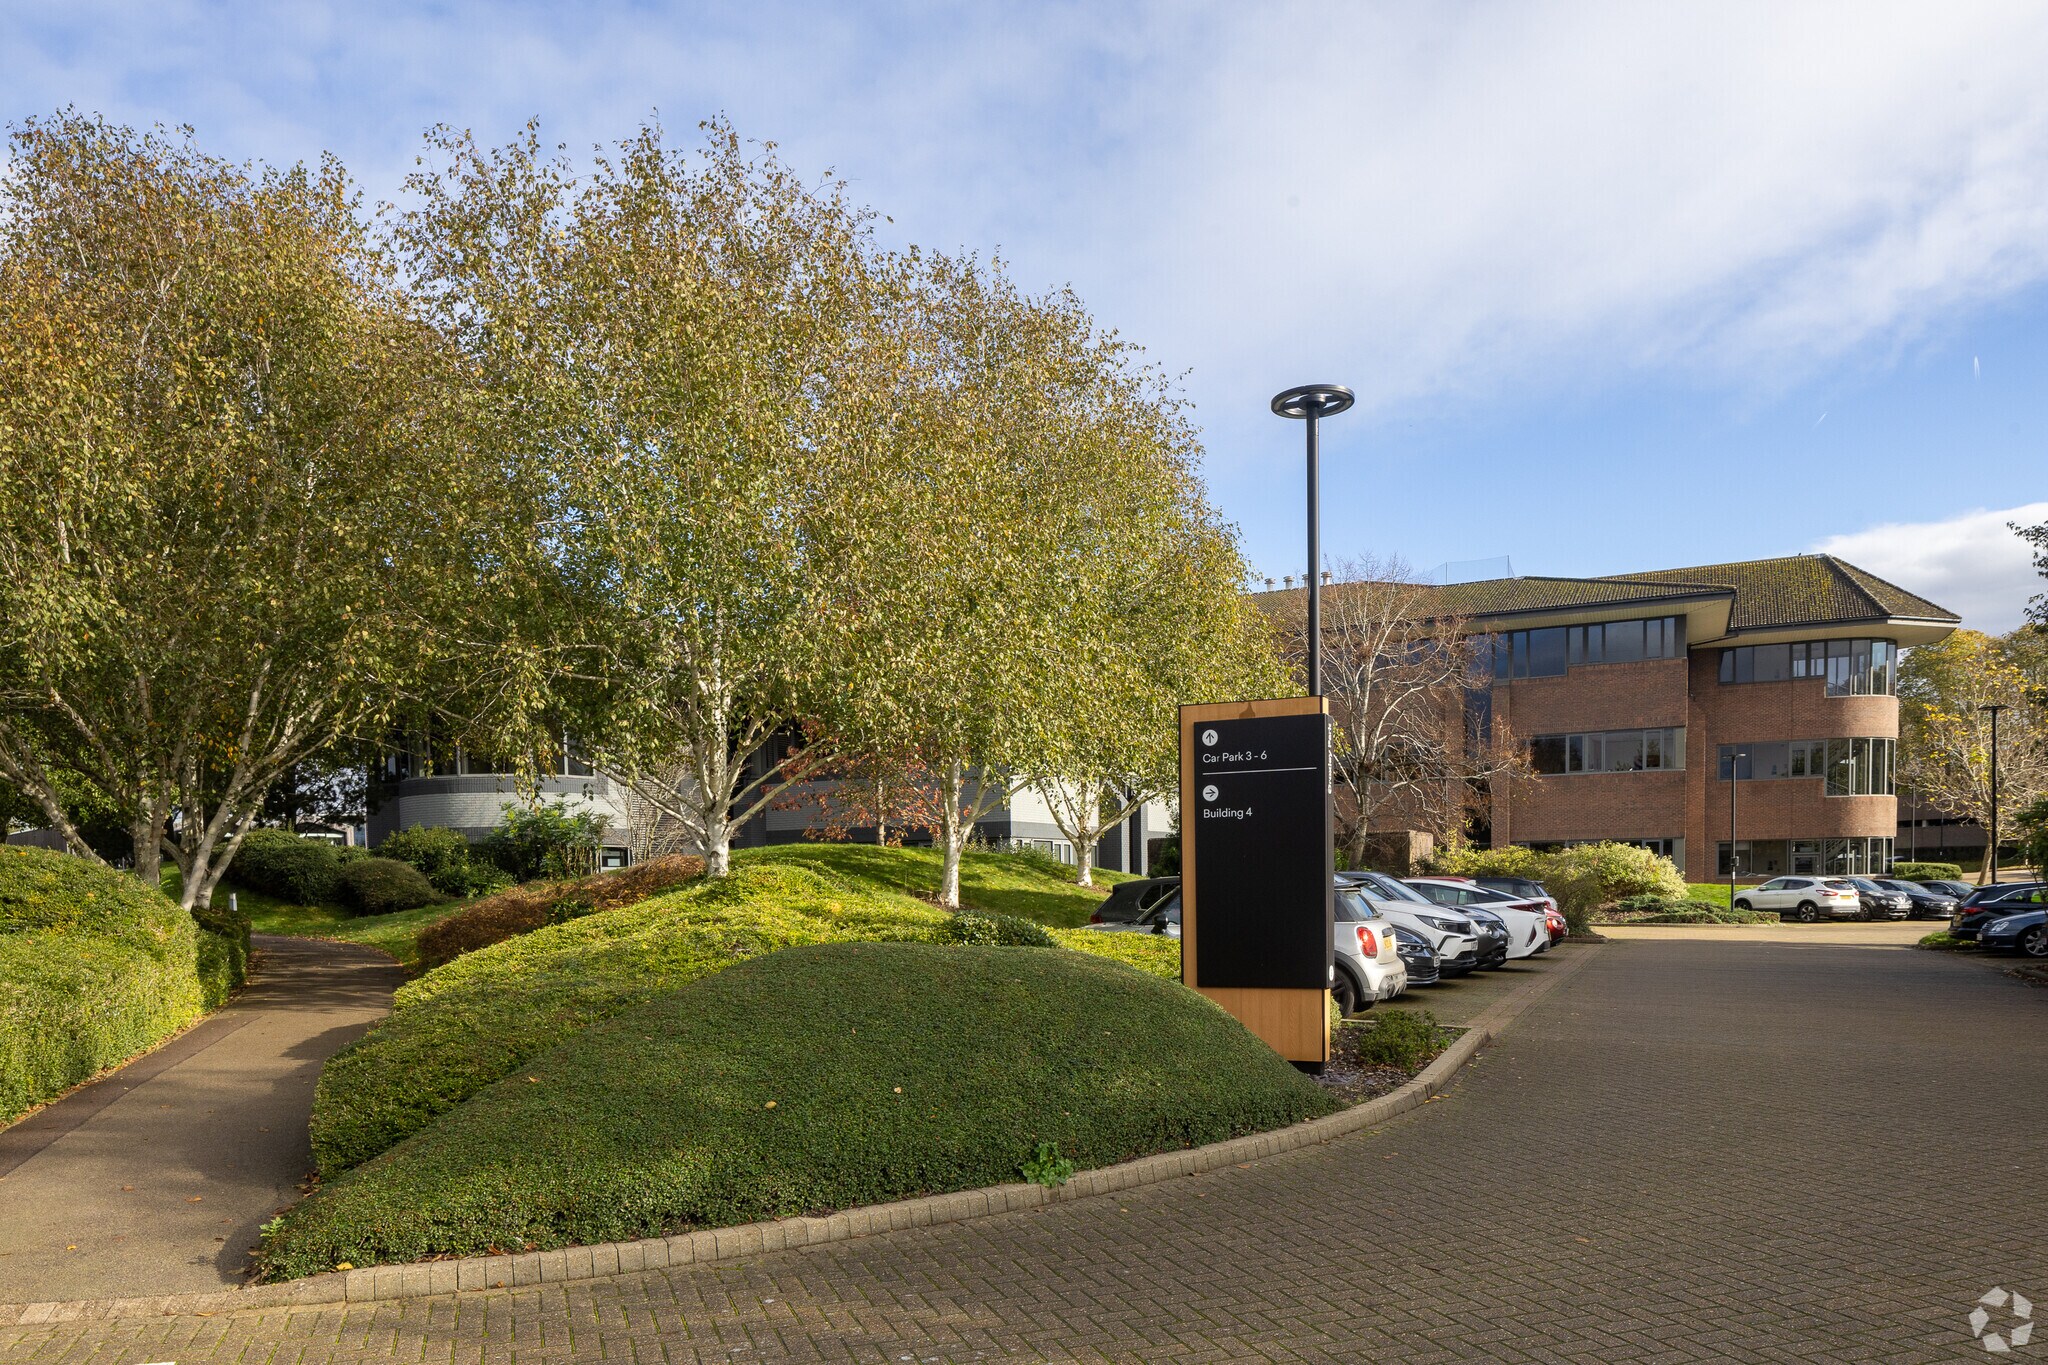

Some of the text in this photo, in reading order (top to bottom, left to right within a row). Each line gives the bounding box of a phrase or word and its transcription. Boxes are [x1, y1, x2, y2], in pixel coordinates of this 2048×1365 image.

[1202, 753, 1220, 763] Car
[1222, 751, 1244, 762] Park
[1245, 751, 1252, 761] 3
[1260, 750, 1267, 760] 6
[1203, 807, 1253, 820] Building 4
